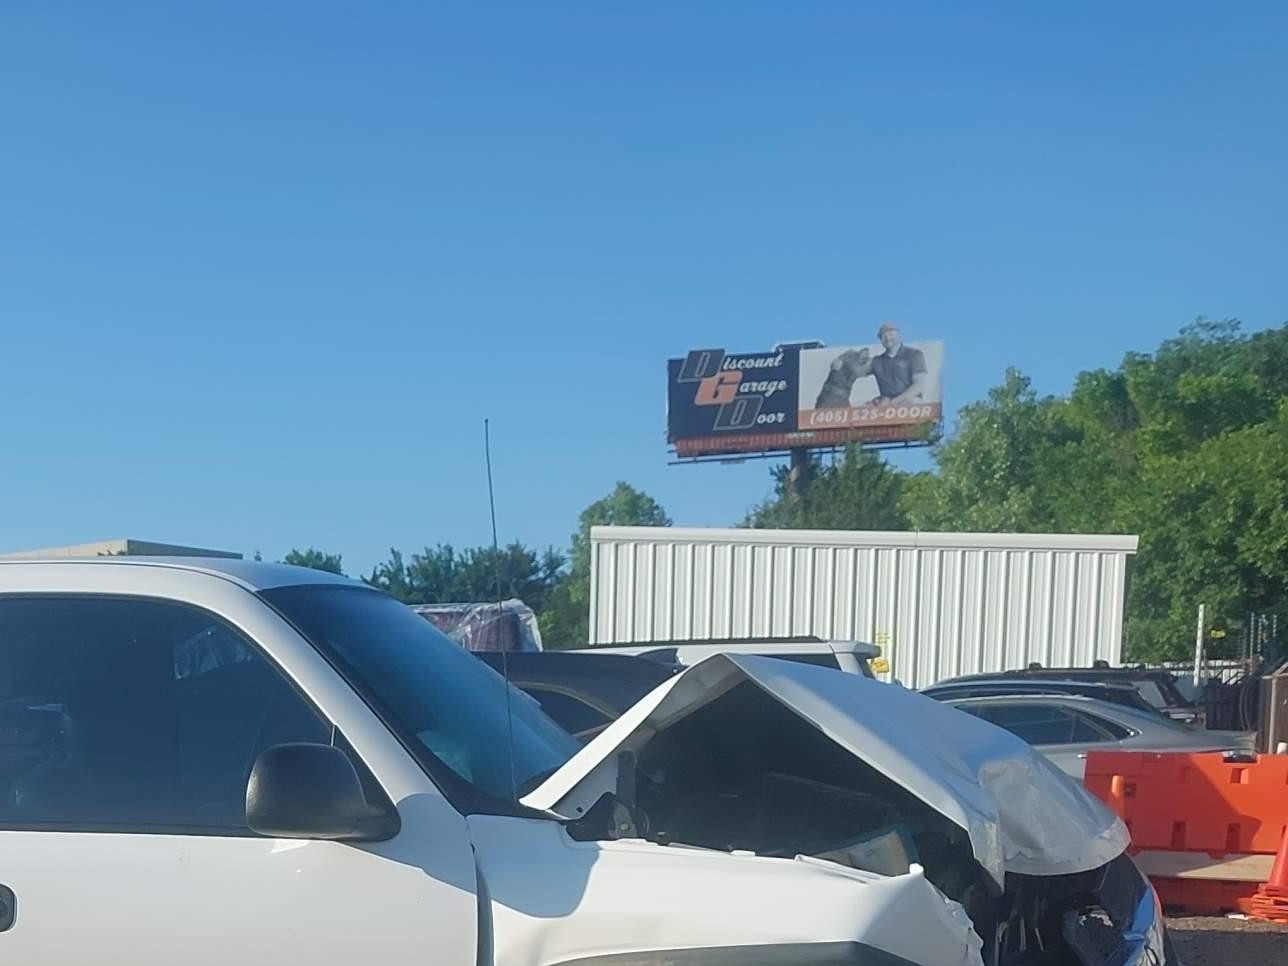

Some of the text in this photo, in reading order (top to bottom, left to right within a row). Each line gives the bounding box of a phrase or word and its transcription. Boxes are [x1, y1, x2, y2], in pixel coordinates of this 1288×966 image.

[677, 348, 784, 383] Discount
[694, 370, 788, 406] Garage
[713, 395, 785, 431] Door
[810, 405, 932, 425] (405) 525-DOOR
